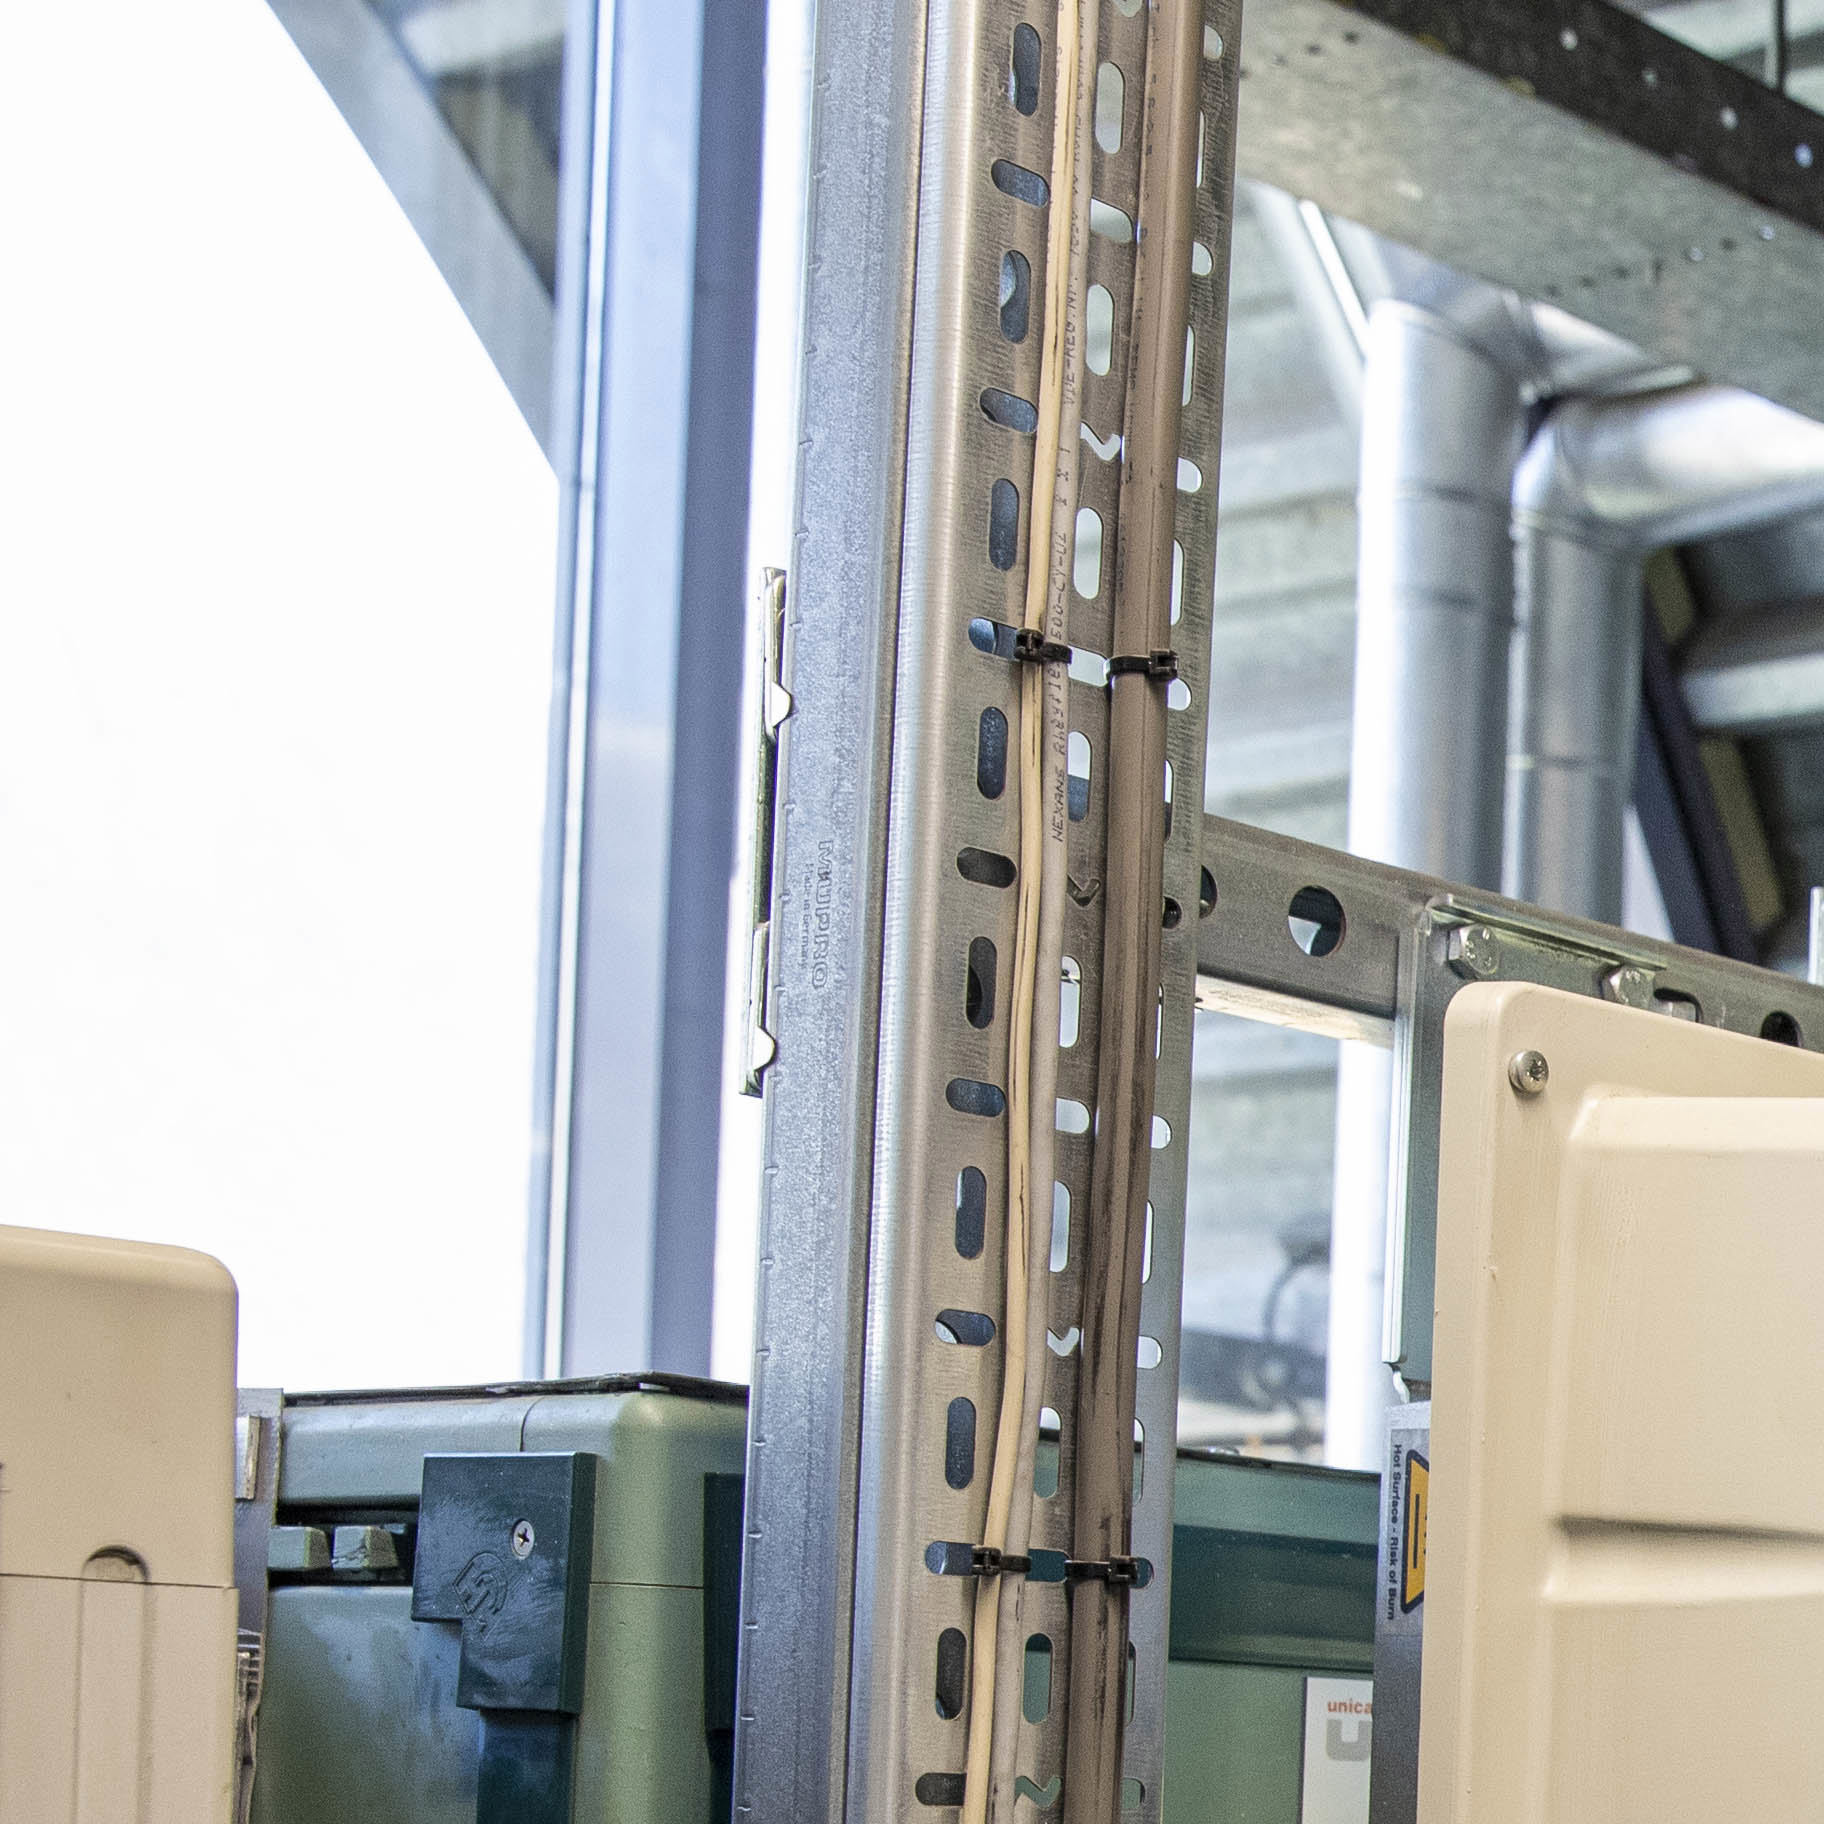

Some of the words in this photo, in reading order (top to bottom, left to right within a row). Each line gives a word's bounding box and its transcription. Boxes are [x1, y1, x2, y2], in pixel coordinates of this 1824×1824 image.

[1392, 1444, 1402, 1468] Hot
[1391, 1471, 1402, 1522] Surface
[1389, 1536, 1400, 1566] Risk
[1388, 1569, 1398, 1585] of
[1386, 1588, 1397, 1621] Burn
